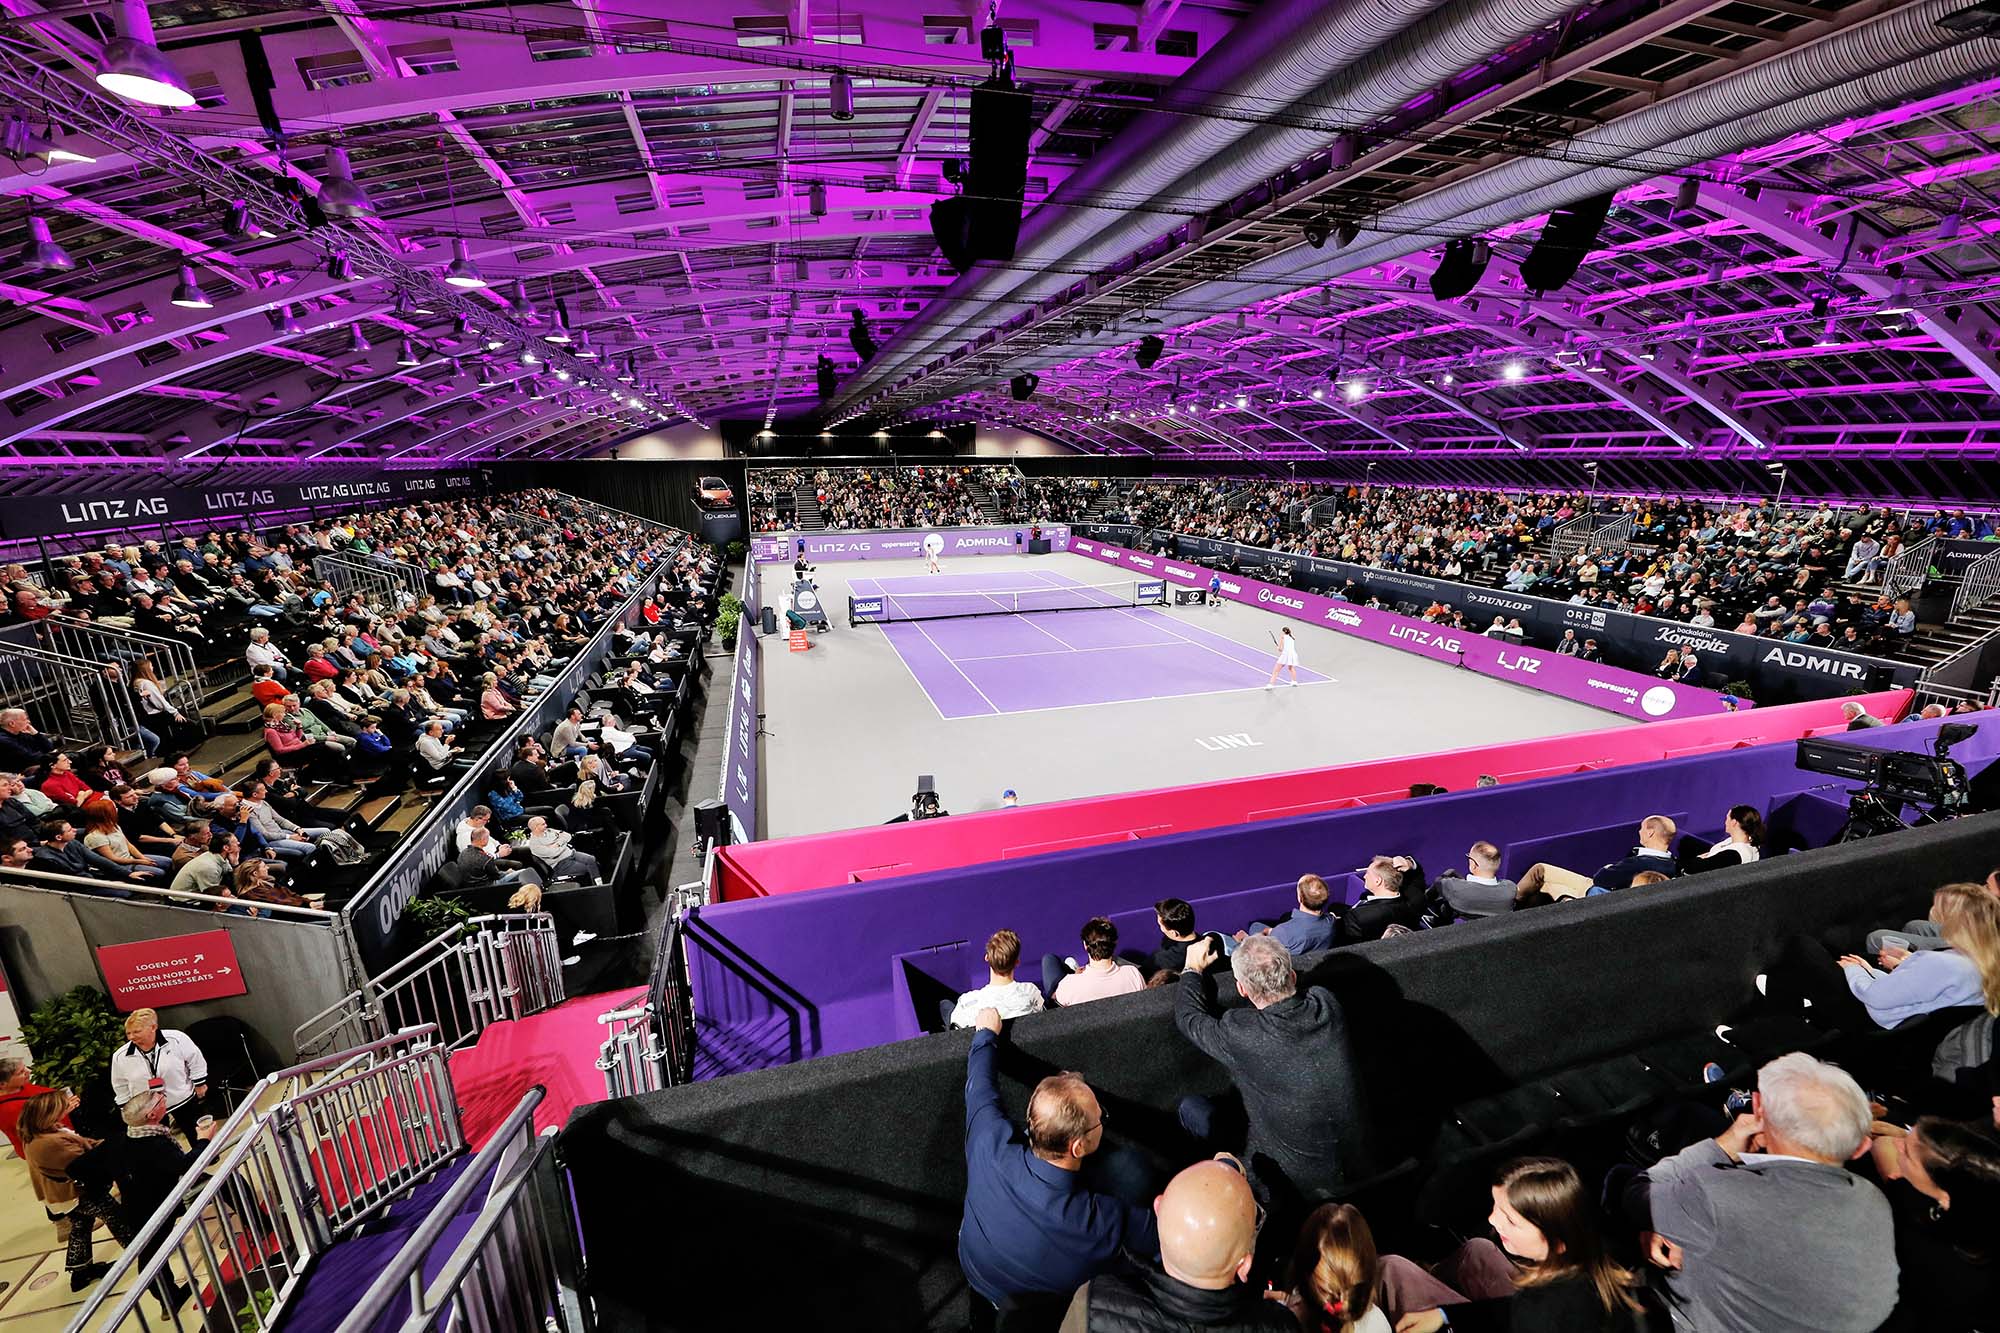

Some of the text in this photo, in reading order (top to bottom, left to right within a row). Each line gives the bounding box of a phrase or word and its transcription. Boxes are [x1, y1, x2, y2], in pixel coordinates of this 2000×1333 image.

[299, 484, 349, 501] LINZ AG
[349, 482, 391, 496] LINZ AG
[404, 479, 436, 492] LINZ AG
[204, 490, 275, 510] LINZ AG
[61, 497, 169, 523] LINZ AG
[810, 542, 871, 553] LINZ AG
[881, 540, 920, 549] upperaustria
[955, 536, 1012, 548] ADMIRAL
[1267, 555, 1285, 564] LINZ
[855, 601, 881, 609] HOLOGIC
[1269, 594, 1304, 610] LEXUS
[1477, 594, 1533, 612] DUNLOP
[1566, 609, 1592, 621] ORF
[1389, 624, 1461, 653] LINZ AG
[1654, 626, 1730, 654] Kornspitz
[1587, 678, 1639, 698] upperaustria
[1623, 696, 1636, 705] .at
[1194, 732, 1264, 751] LINZ
[136, 957, 189, 972] LOGEN OST
[118, 973, 214, 994] VIP-BUSINESS-SEATS
[127, 974, 161, 985] LOGEN
[163, 970, 191, 980] NORD
